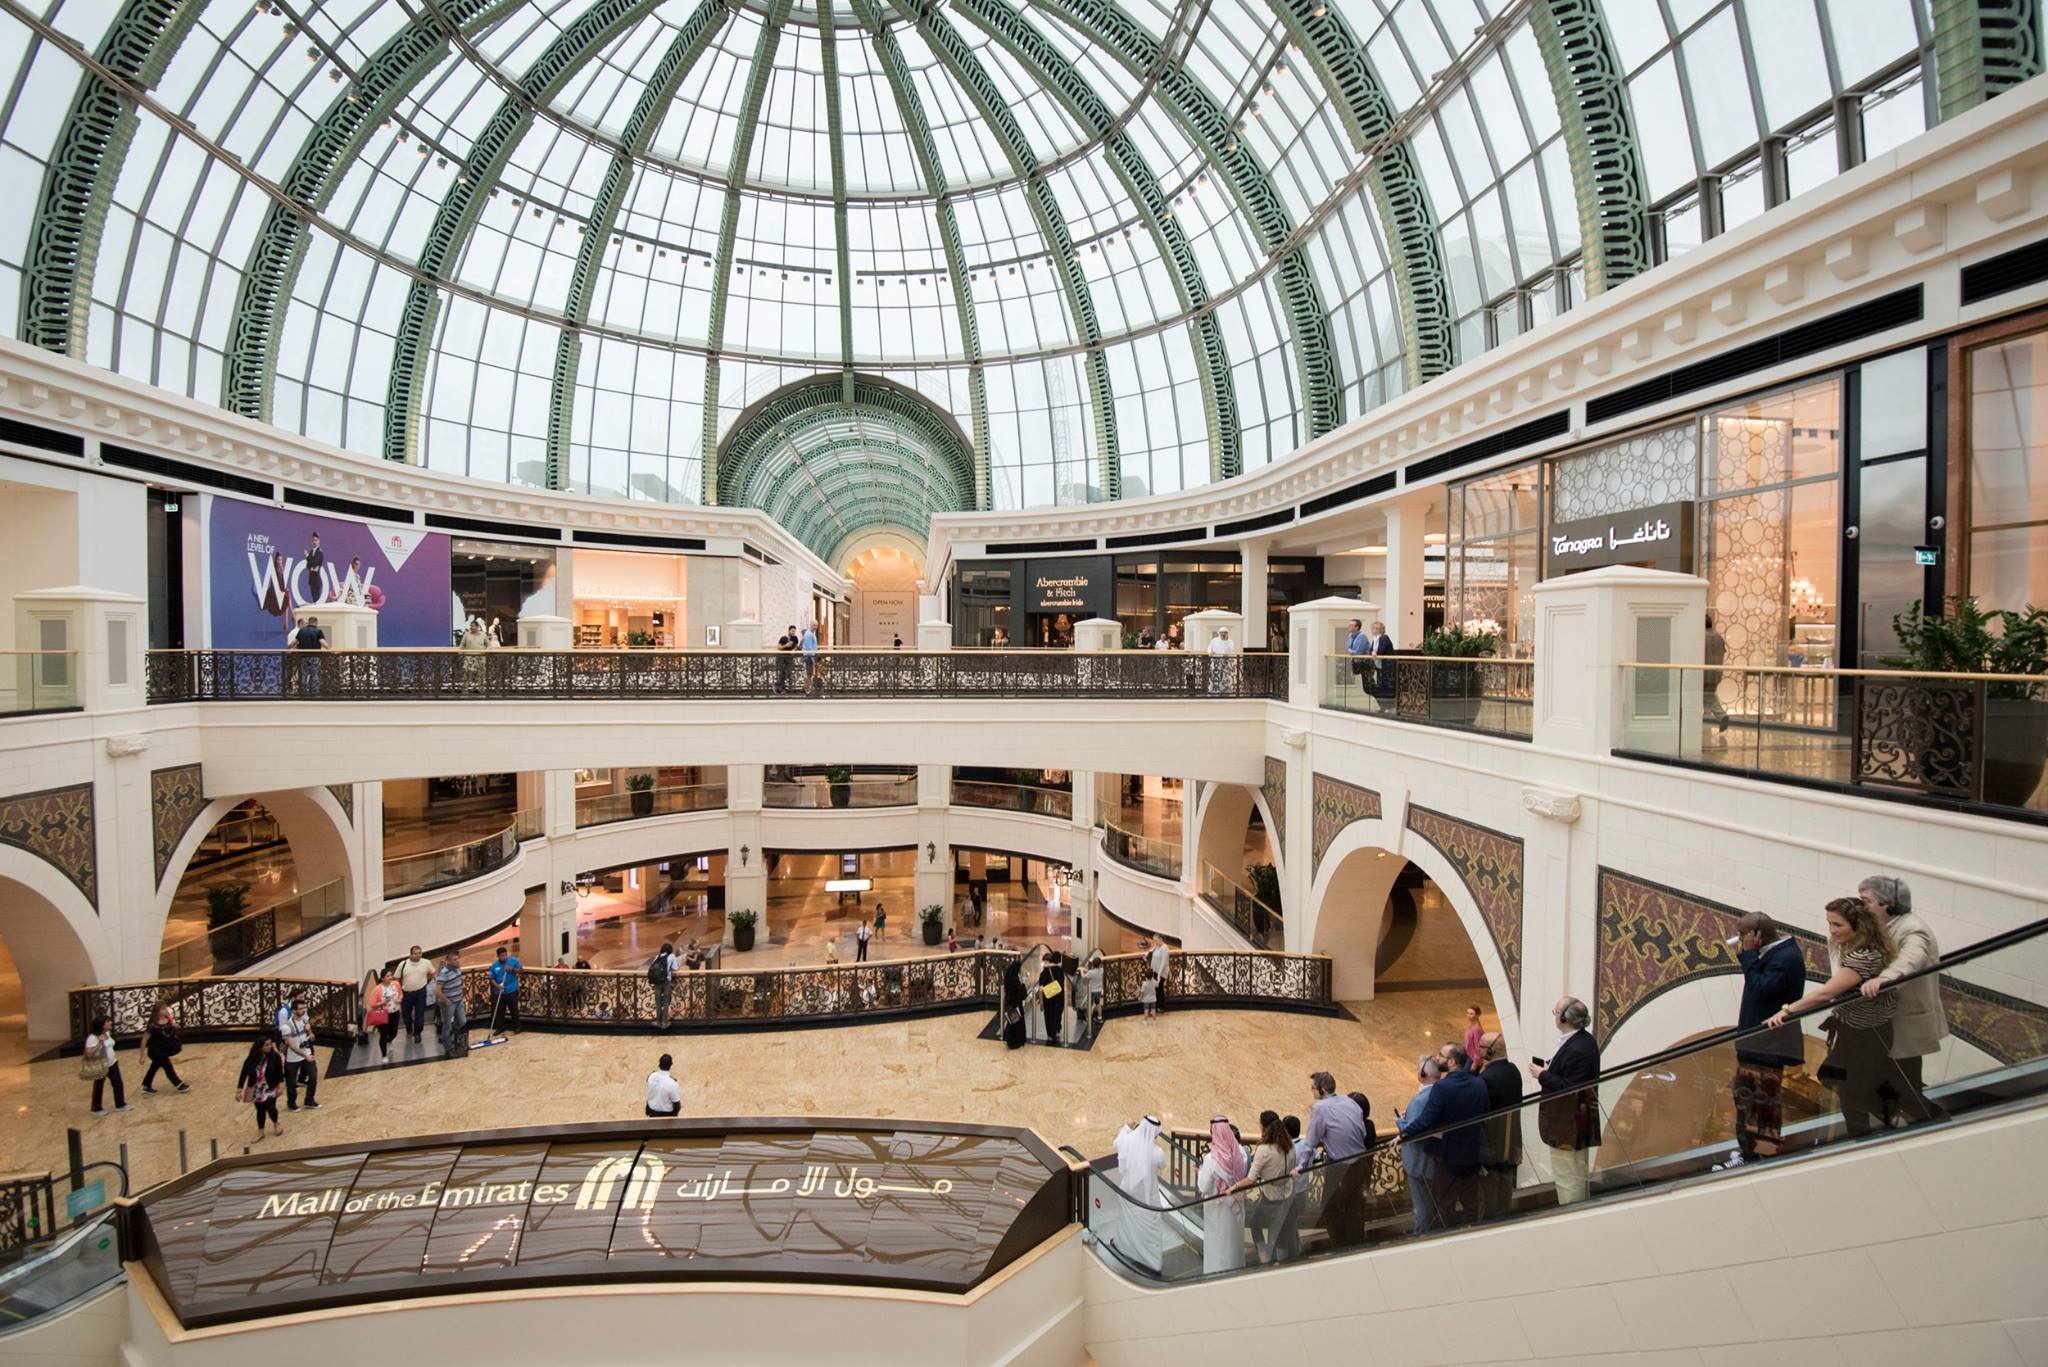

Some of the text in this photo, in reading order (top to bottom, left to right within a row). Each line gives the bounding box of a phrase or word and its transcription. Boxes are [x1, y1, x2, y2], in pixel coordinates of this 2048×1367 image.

[248, 533, 270, 545] A NEW
[1552, 535, 1604, 556] Tanagra
[247, 542, 276, 554] LEVEL OF
[248, 552, 376, 610] WOW
[1036, 575, 1089, 588] Abercrombie
[1046, 586, 1076, 598] & Fitch
[833, 1167, 953, 1199] مول
[256, 1178, 570, 1219] Mall of the Emirates
